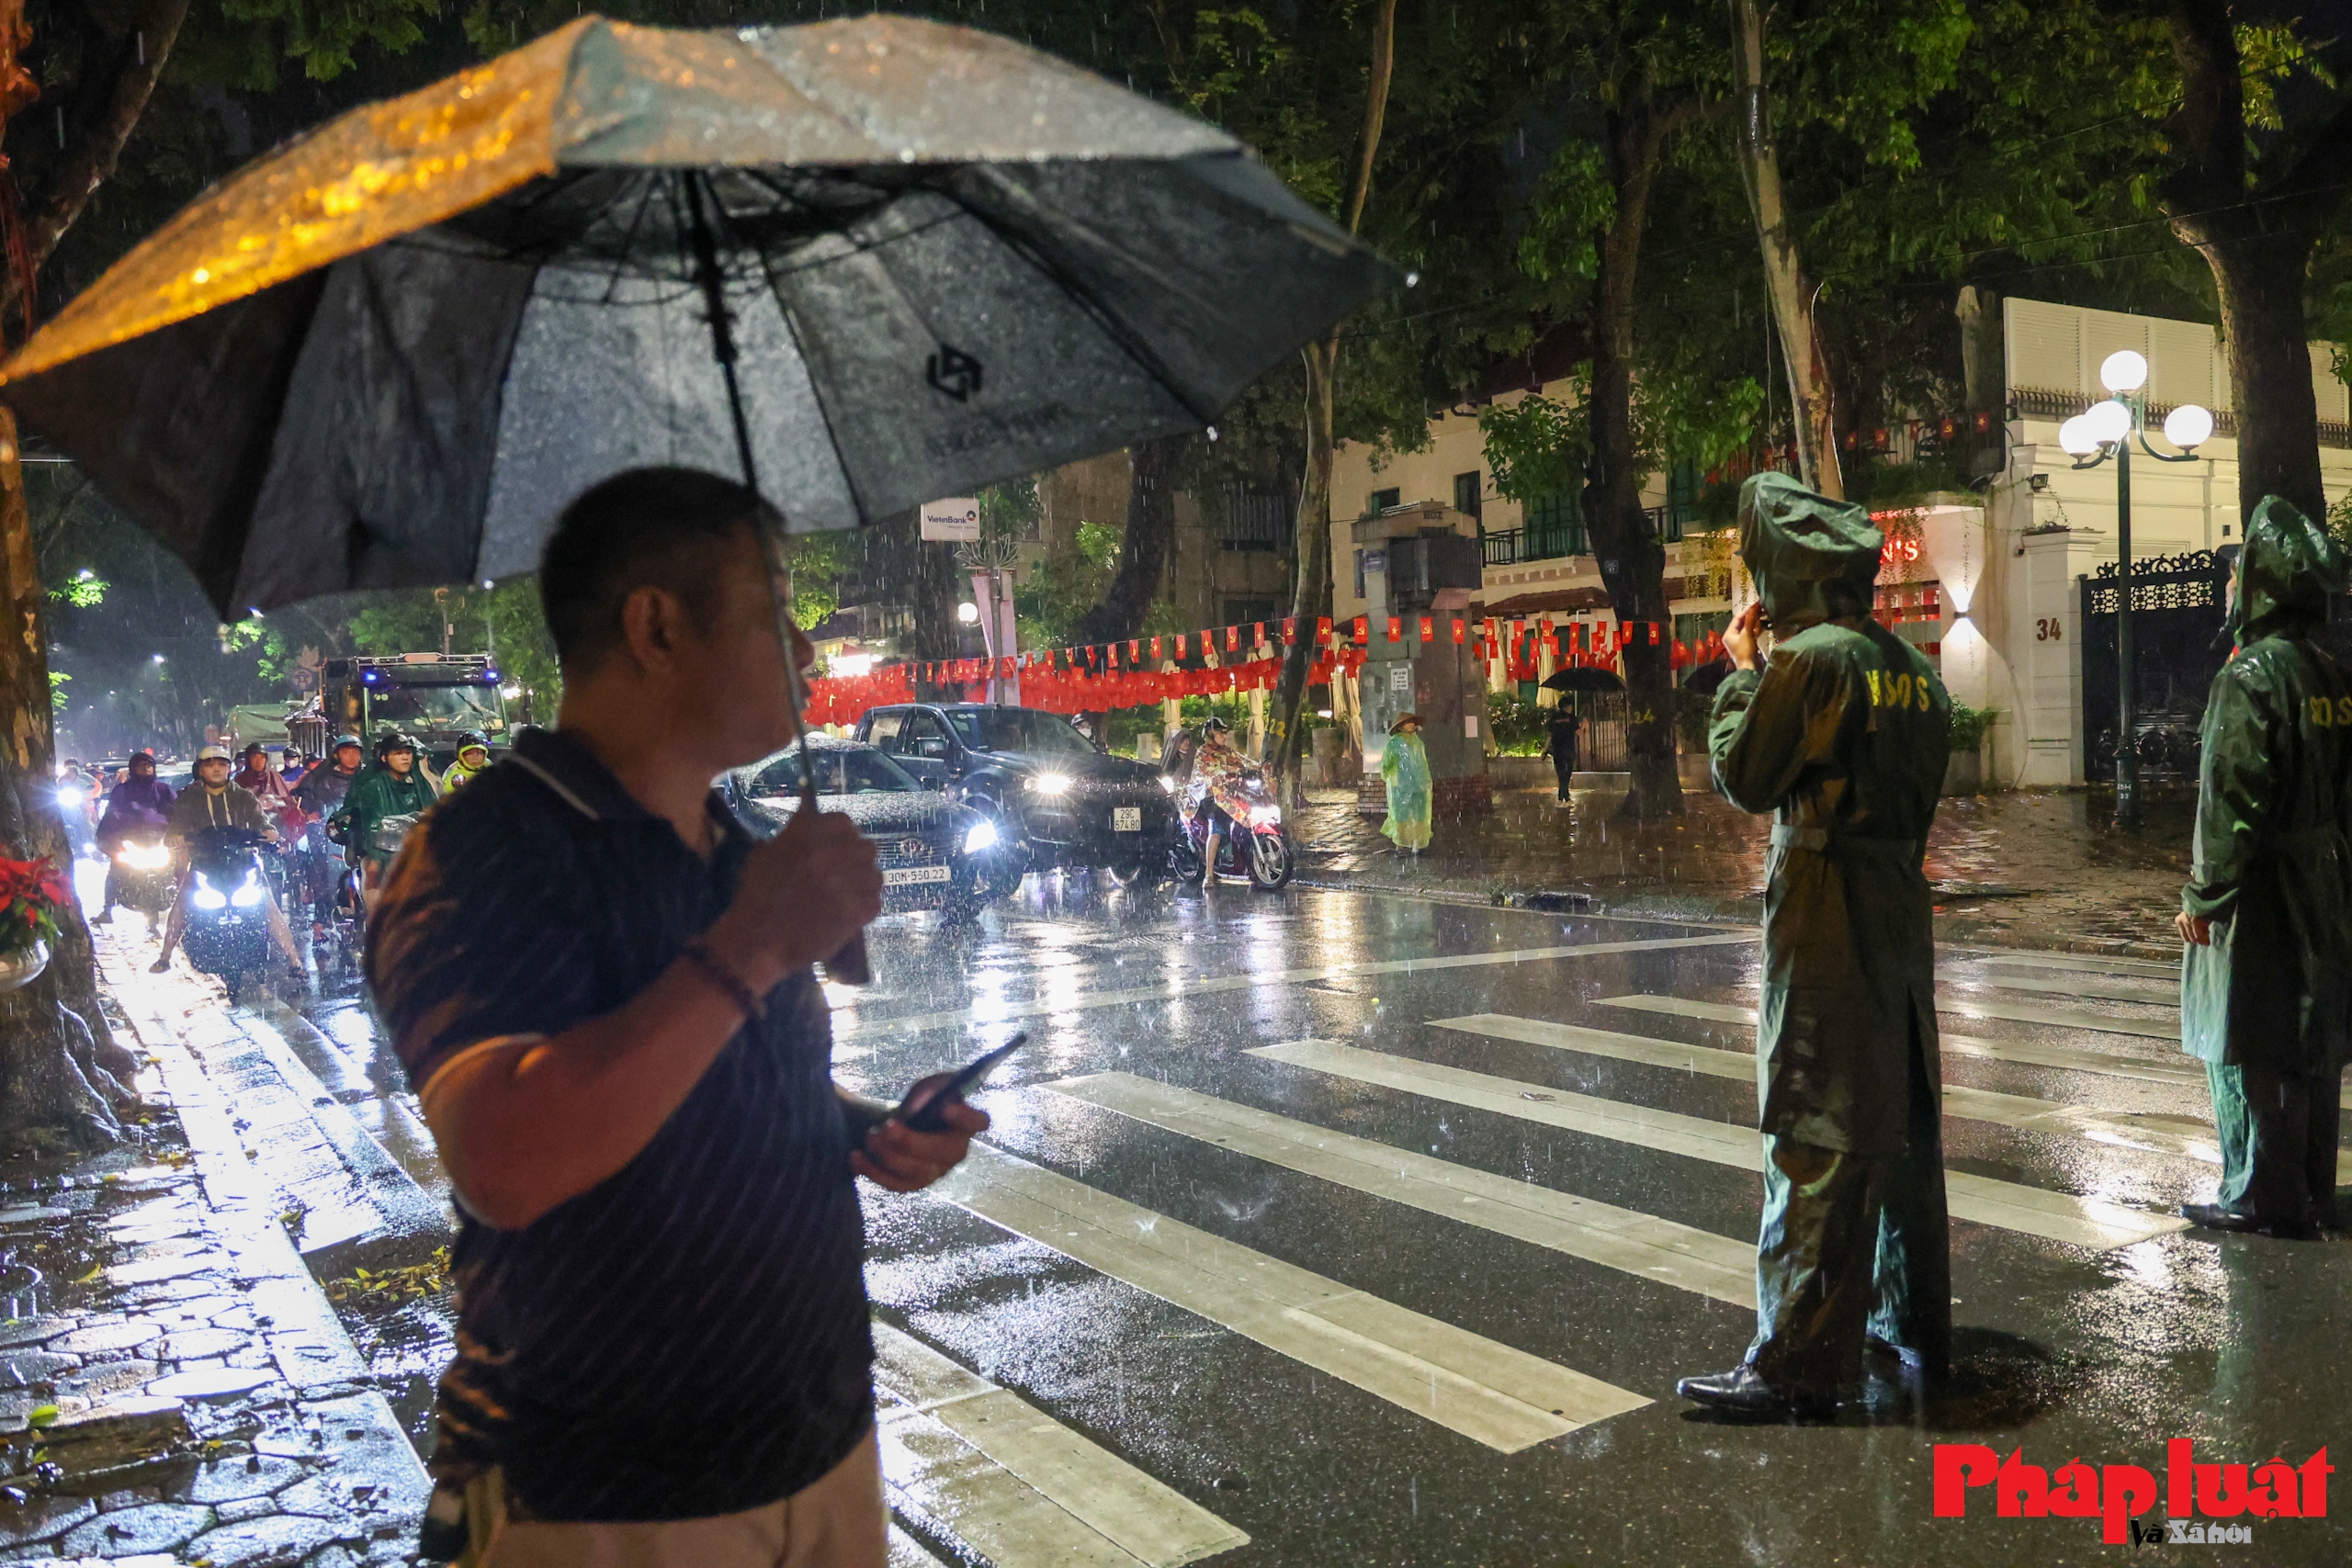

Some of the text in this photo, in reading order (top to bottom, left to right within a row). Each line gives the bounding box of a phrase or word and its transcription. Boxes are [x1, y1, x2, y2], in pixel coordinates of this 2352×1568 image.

[927, 515, 967, 524] VietinBank
[2036, 617, 2062, 641] 34
[1120, 808, 1135, 819] 29C
